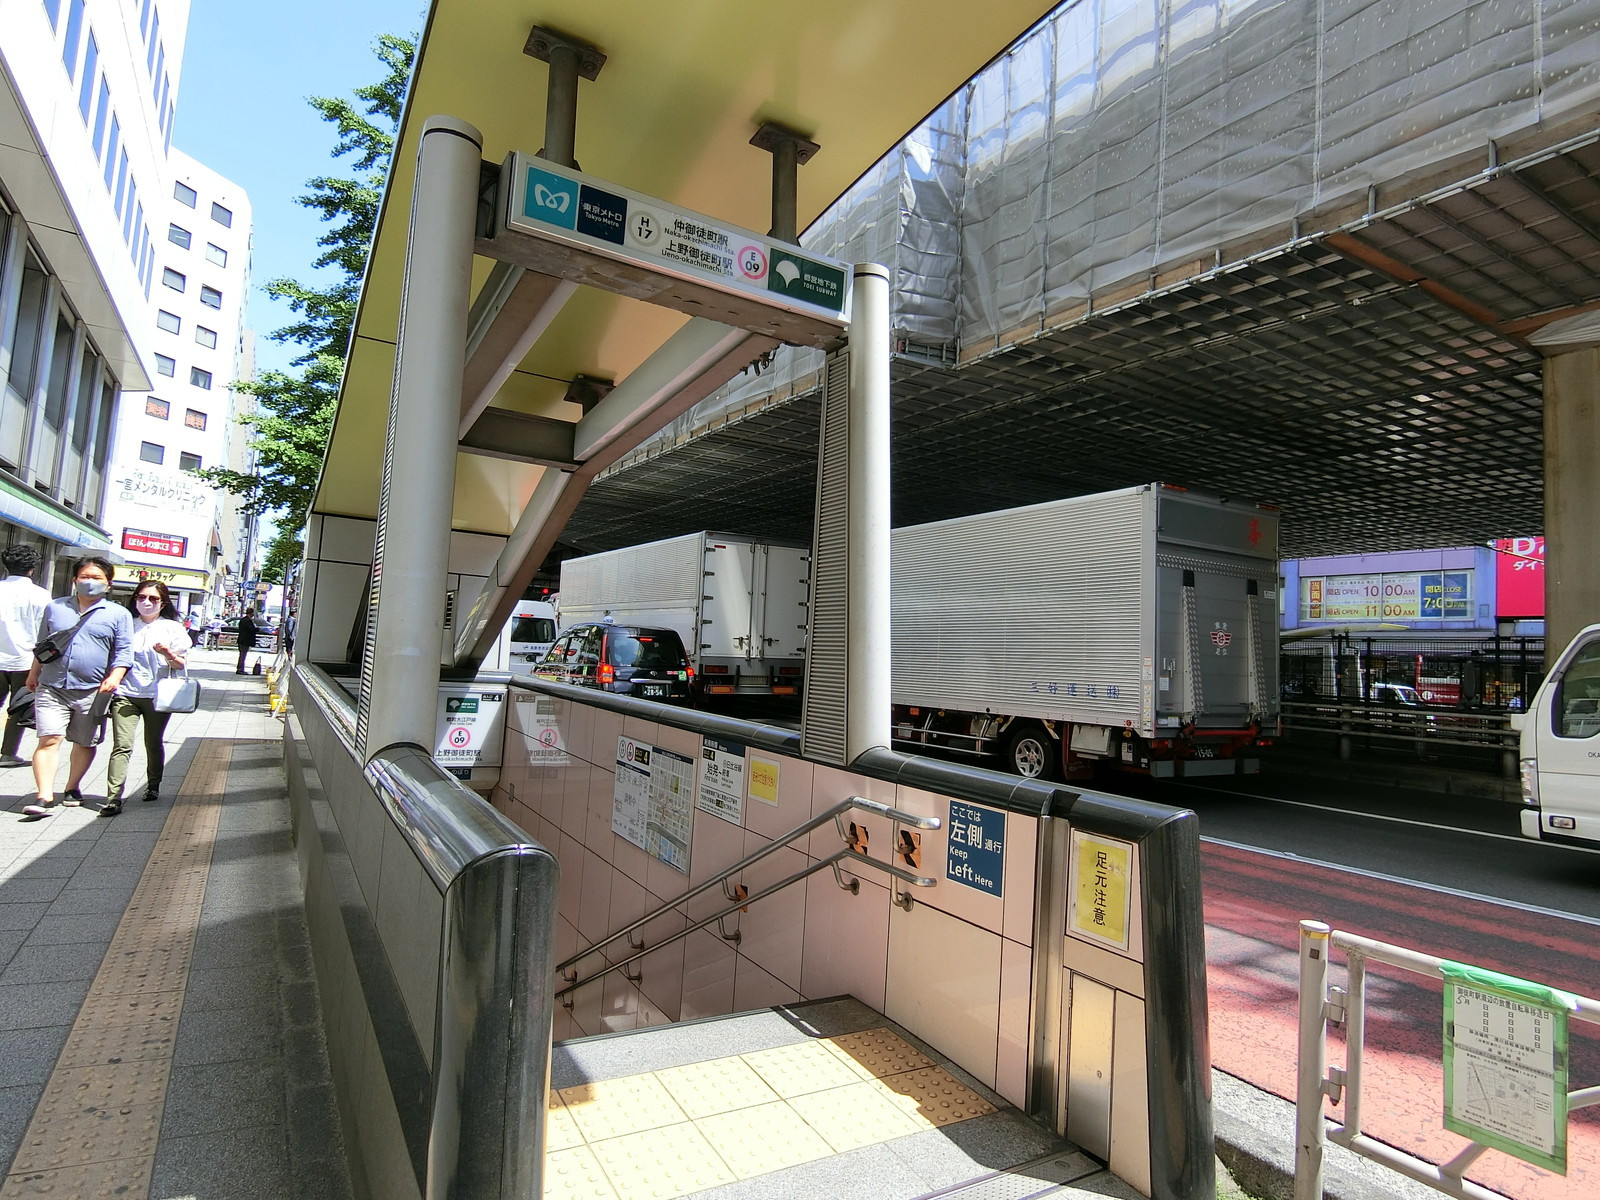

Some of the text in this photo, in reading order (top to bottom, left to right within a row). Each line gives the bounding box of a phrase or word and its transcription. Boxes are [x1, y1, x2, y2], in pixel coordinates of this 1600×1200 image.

[583, 202, 623, 221] 東京メトロ
[585, 211, 620, 228] Tokyo Metro
[641, 216, 650, 228] H
[638, 226, 653, 239] 17
[664, 227, 736, 256] Naka-okachimachi Sta.
[674, 218, 729, 247] 仲御徒町駅
[665, 239, 733, 270] 上野御徒町駅
[750, 251, 757, 262] E
[661, 250, 735, 278] Ueno-okachimachi Sta.
[745, 260, 760, 273] 09
[803, 273, 838, 291] 都営地下鉄
[803, 282, 838, 298] TOEI SUBWAY
[1513, 537, 1544, 555] D
[951, 805, 982, 823] ここでは
[950, 819, 1003, 854] 左側 通行
[949, 844, 968, 860] Keep
[949, 859, 994, 888] Left Here
[1093, 851, 1108, 926] 足元注意
